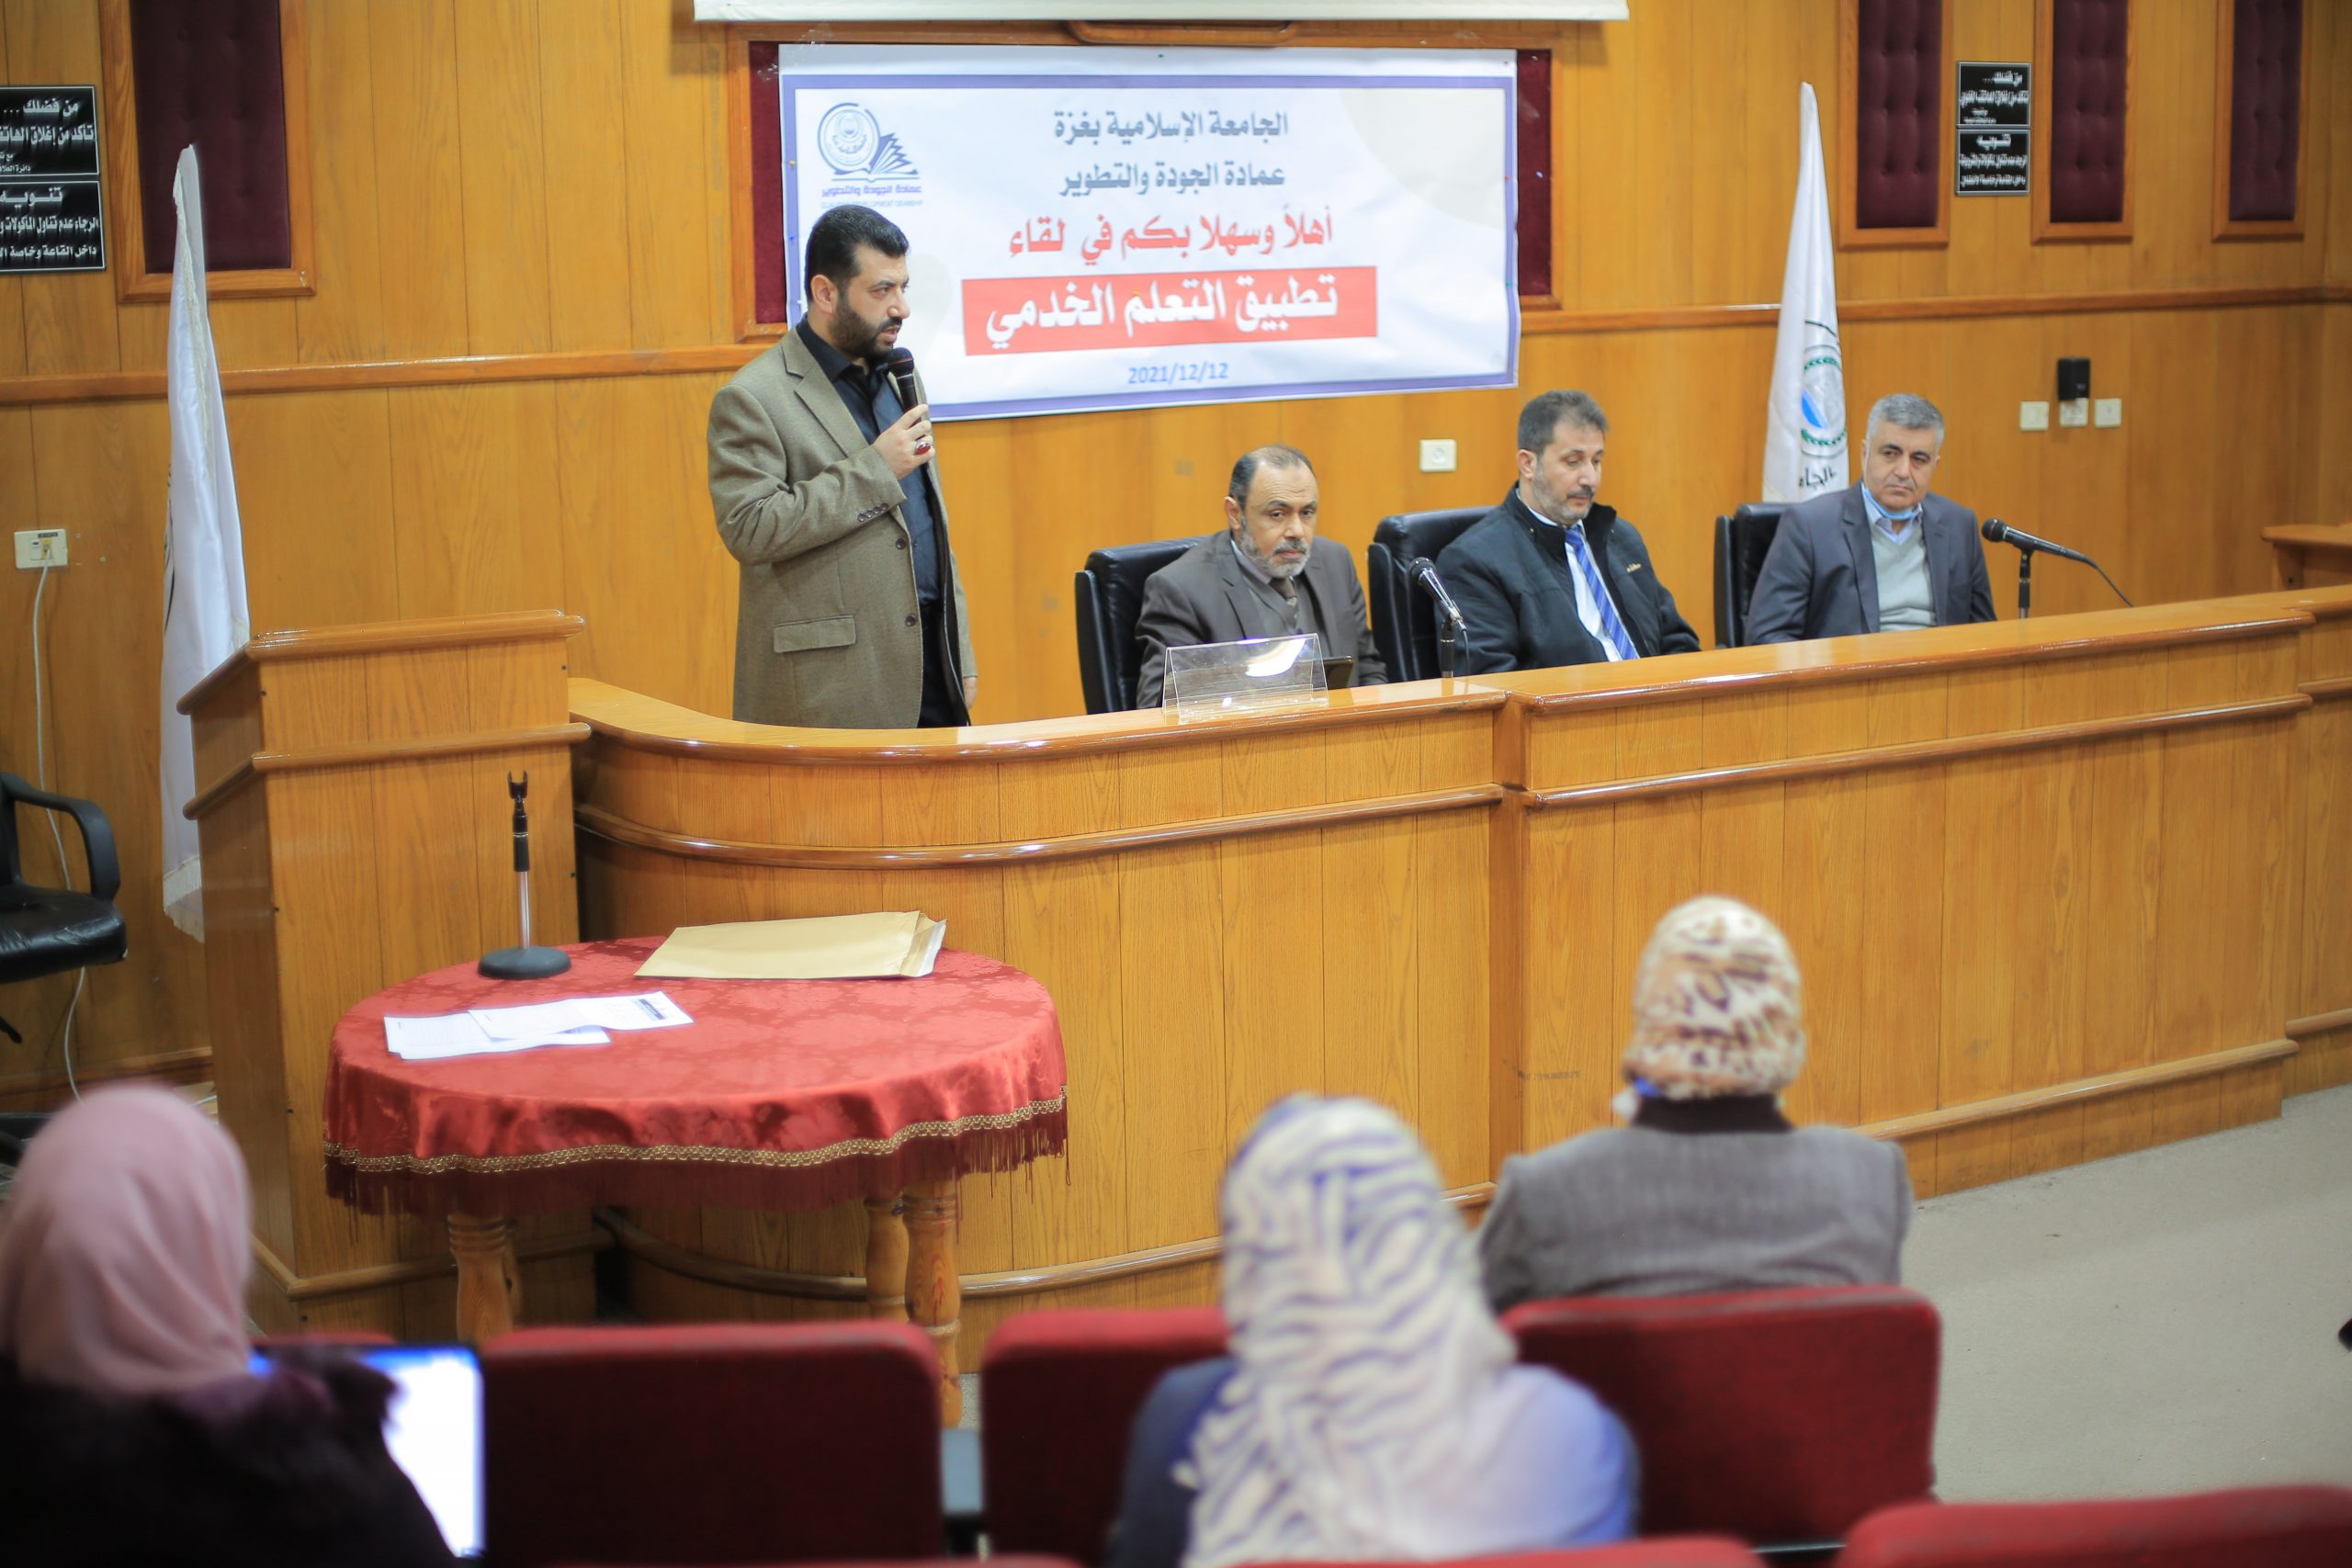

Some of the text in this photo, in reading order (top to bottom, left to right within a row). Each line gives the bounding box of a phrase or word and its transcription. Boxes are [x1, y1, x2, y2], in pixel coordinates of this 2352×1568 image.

[23, 97, 60, 113] فضلك
[62, 99, 78, 117] من
[30, 125, 56, 145] إغلاق
[58, 127, 70, 145] من
[1054, 109, 1288, 145] الجامعة الإسلامية بغزة
[1057, 161, 1285, 197] عمادة الجودة والتطوير
[37, 215, 59, 233] تناول
[1198, 213, 1275, 257] وسهلا
[1009, 216, 1067, 258] لقاء
[1080, 214, 1114, 266] في
[1121, 215, 1191, 260] بكم
[9, 245, 42, 259] وخاصة
[43, 244, 74, 256] القاعة
[986, 274, 1338, 350] تطبيق التعلم الخدمي
[1127, 361, 1230, 385] 2021/12/12
